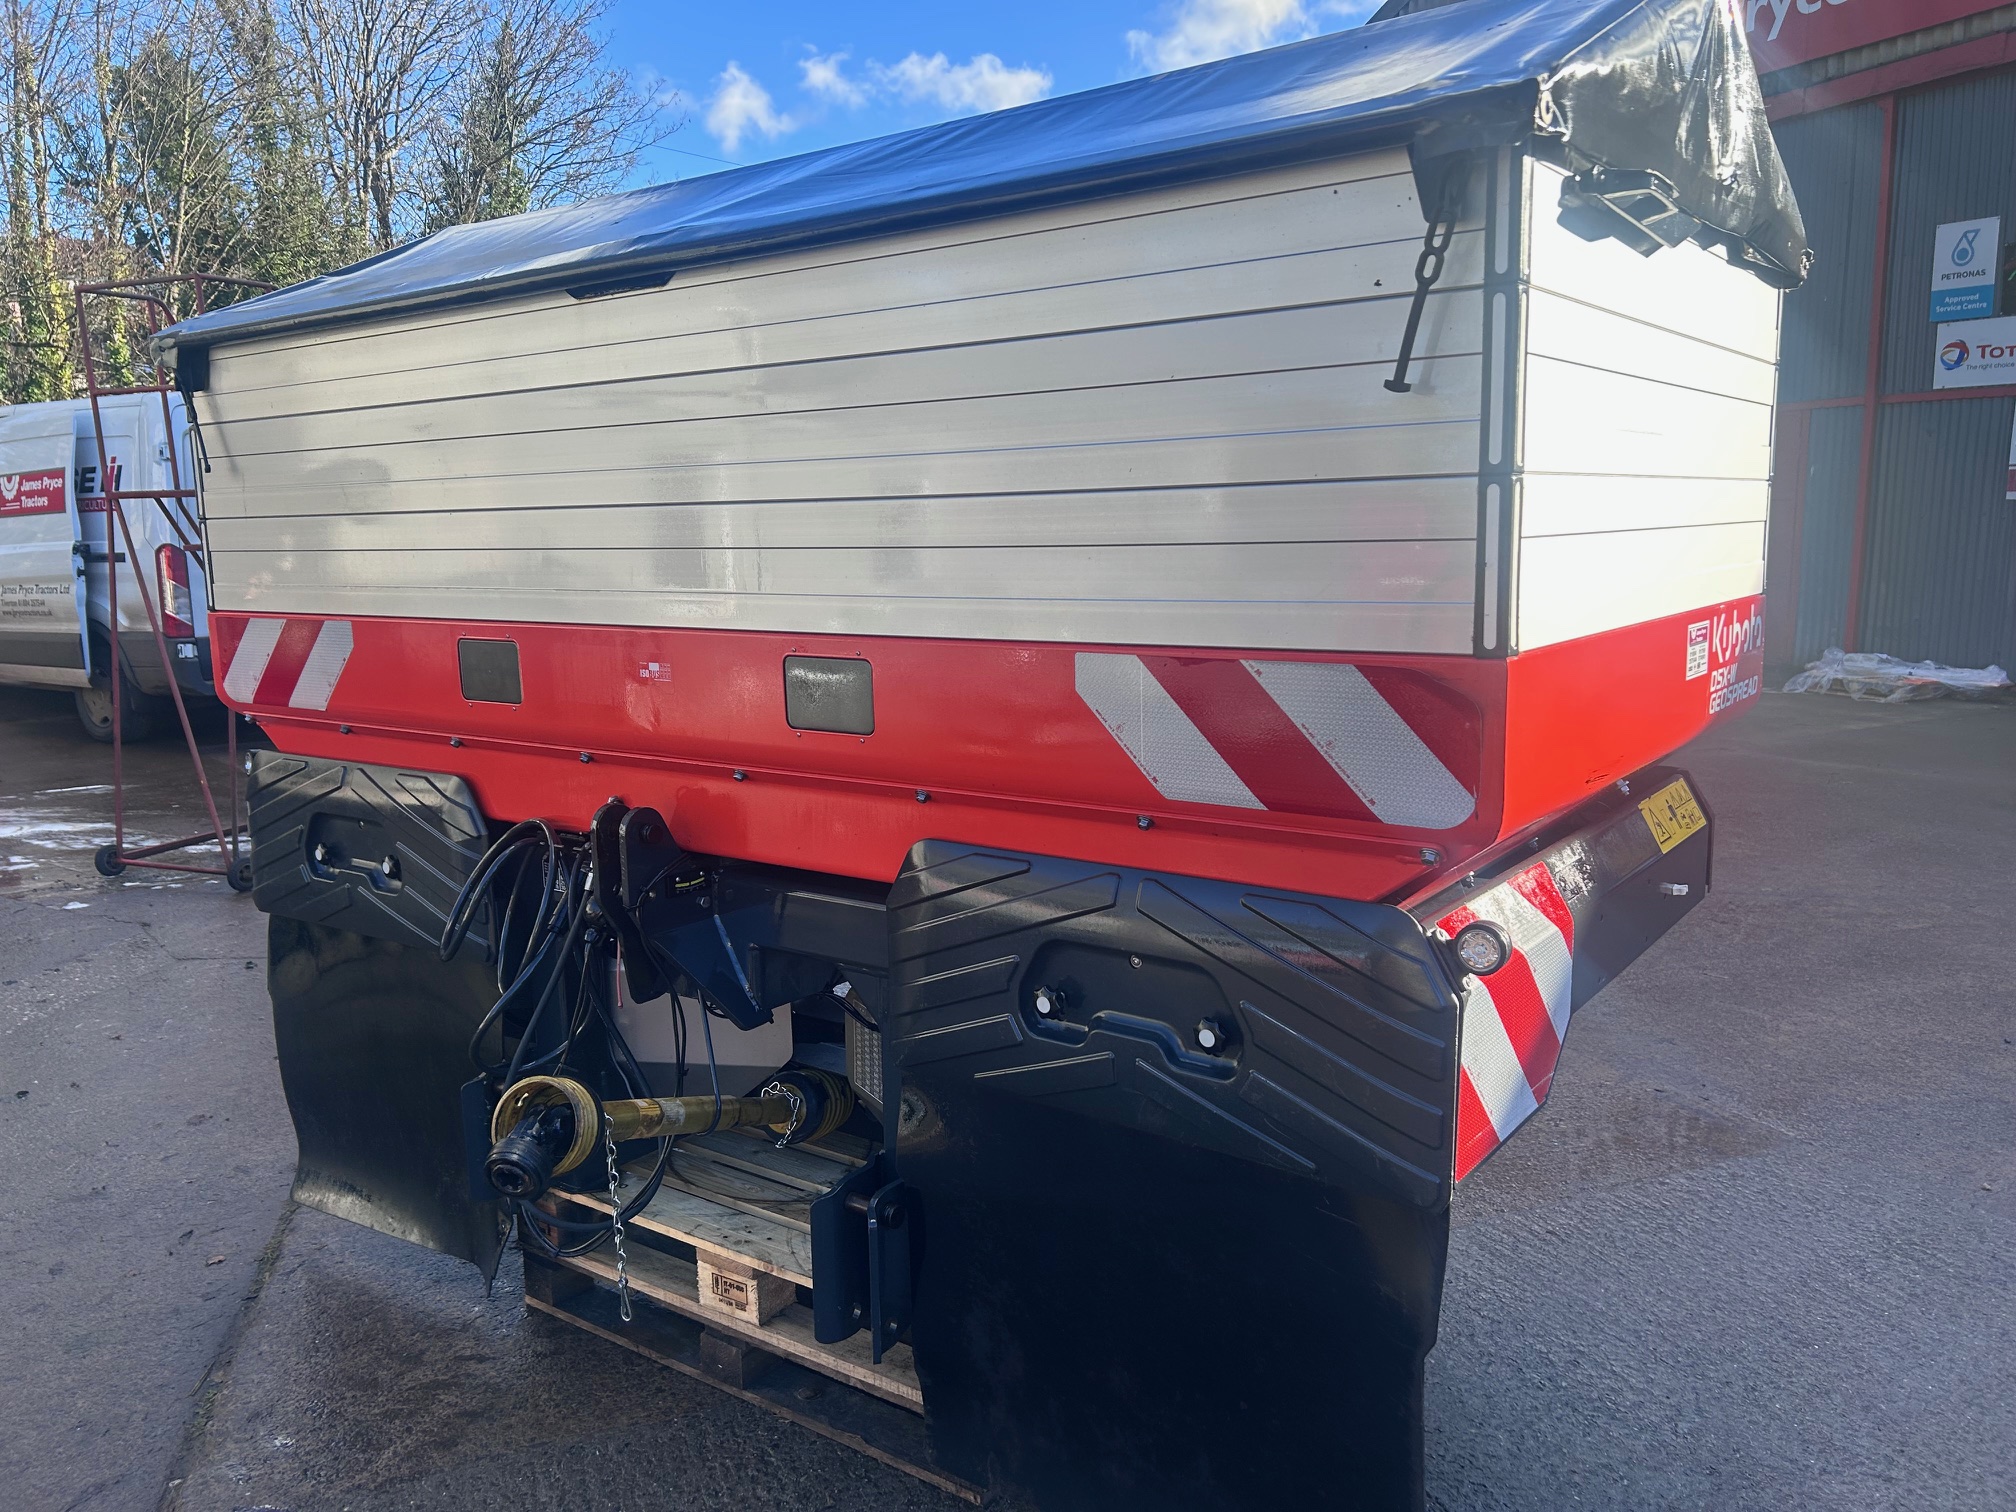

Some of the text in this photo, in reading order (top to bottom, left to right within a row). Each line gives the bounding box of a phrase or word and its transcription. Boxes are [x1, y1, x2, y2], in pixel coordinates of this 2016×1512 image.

[1940, 269, 1986, 281] PETRONAS
[1944, 293, 1980, 304] Approved
[1935, 302, 1987, 313] Service Centre
[1978, 362, 1993, 371] right
[1993, 361, 2015, 369] choice
[21, 476, 63, 492] James Pryce
[20, 495, 48, 508] Tractors
[0, 584, 71, 597] James Pryce Tractors Ltd
[1712, 604, 1762, 664] Kubota
[1709, 675, 1759, 715] GEOSPREAD
